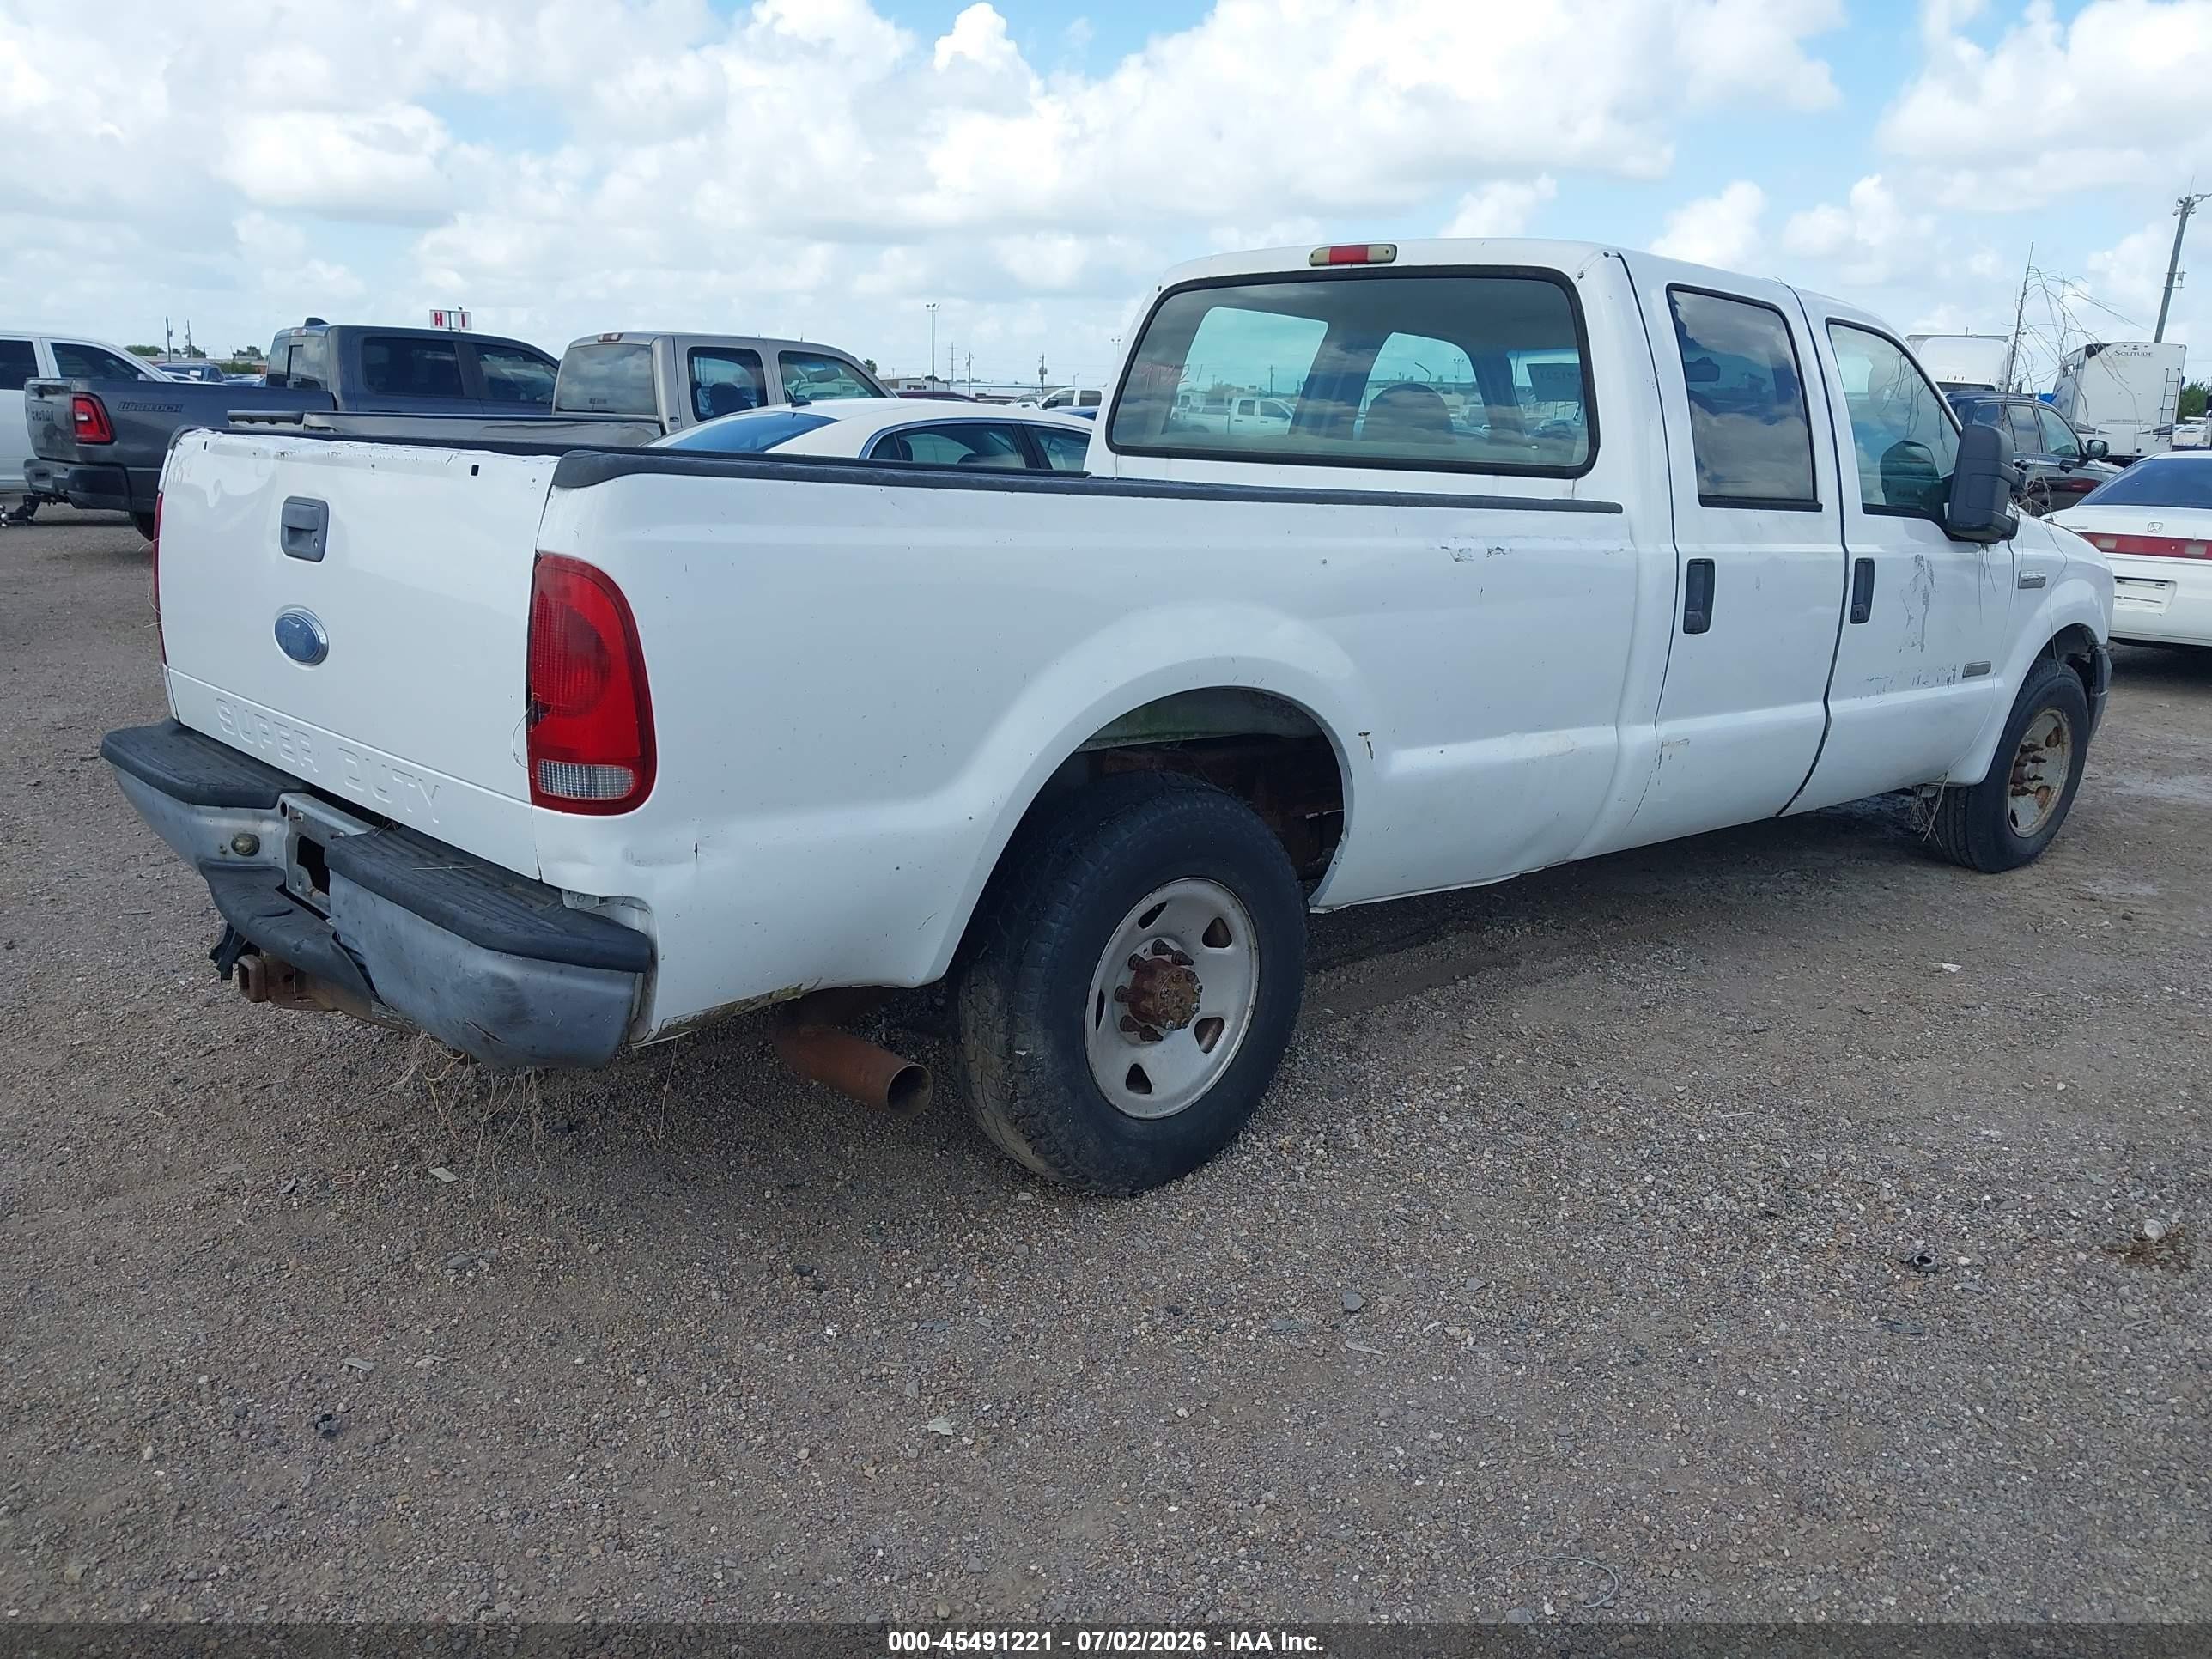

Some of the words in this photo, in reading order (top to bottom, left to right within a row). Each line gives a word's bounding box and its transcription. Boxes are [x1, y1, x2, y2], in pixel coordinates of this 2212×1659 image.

[434, 312, 443, 327] H
[118, 401, 185, 413] WARLOCK
[32, 410, 54, 422] RAM
[216, 697, 319, 773] SUPER
[338, 747, 441, 823] DUTY
